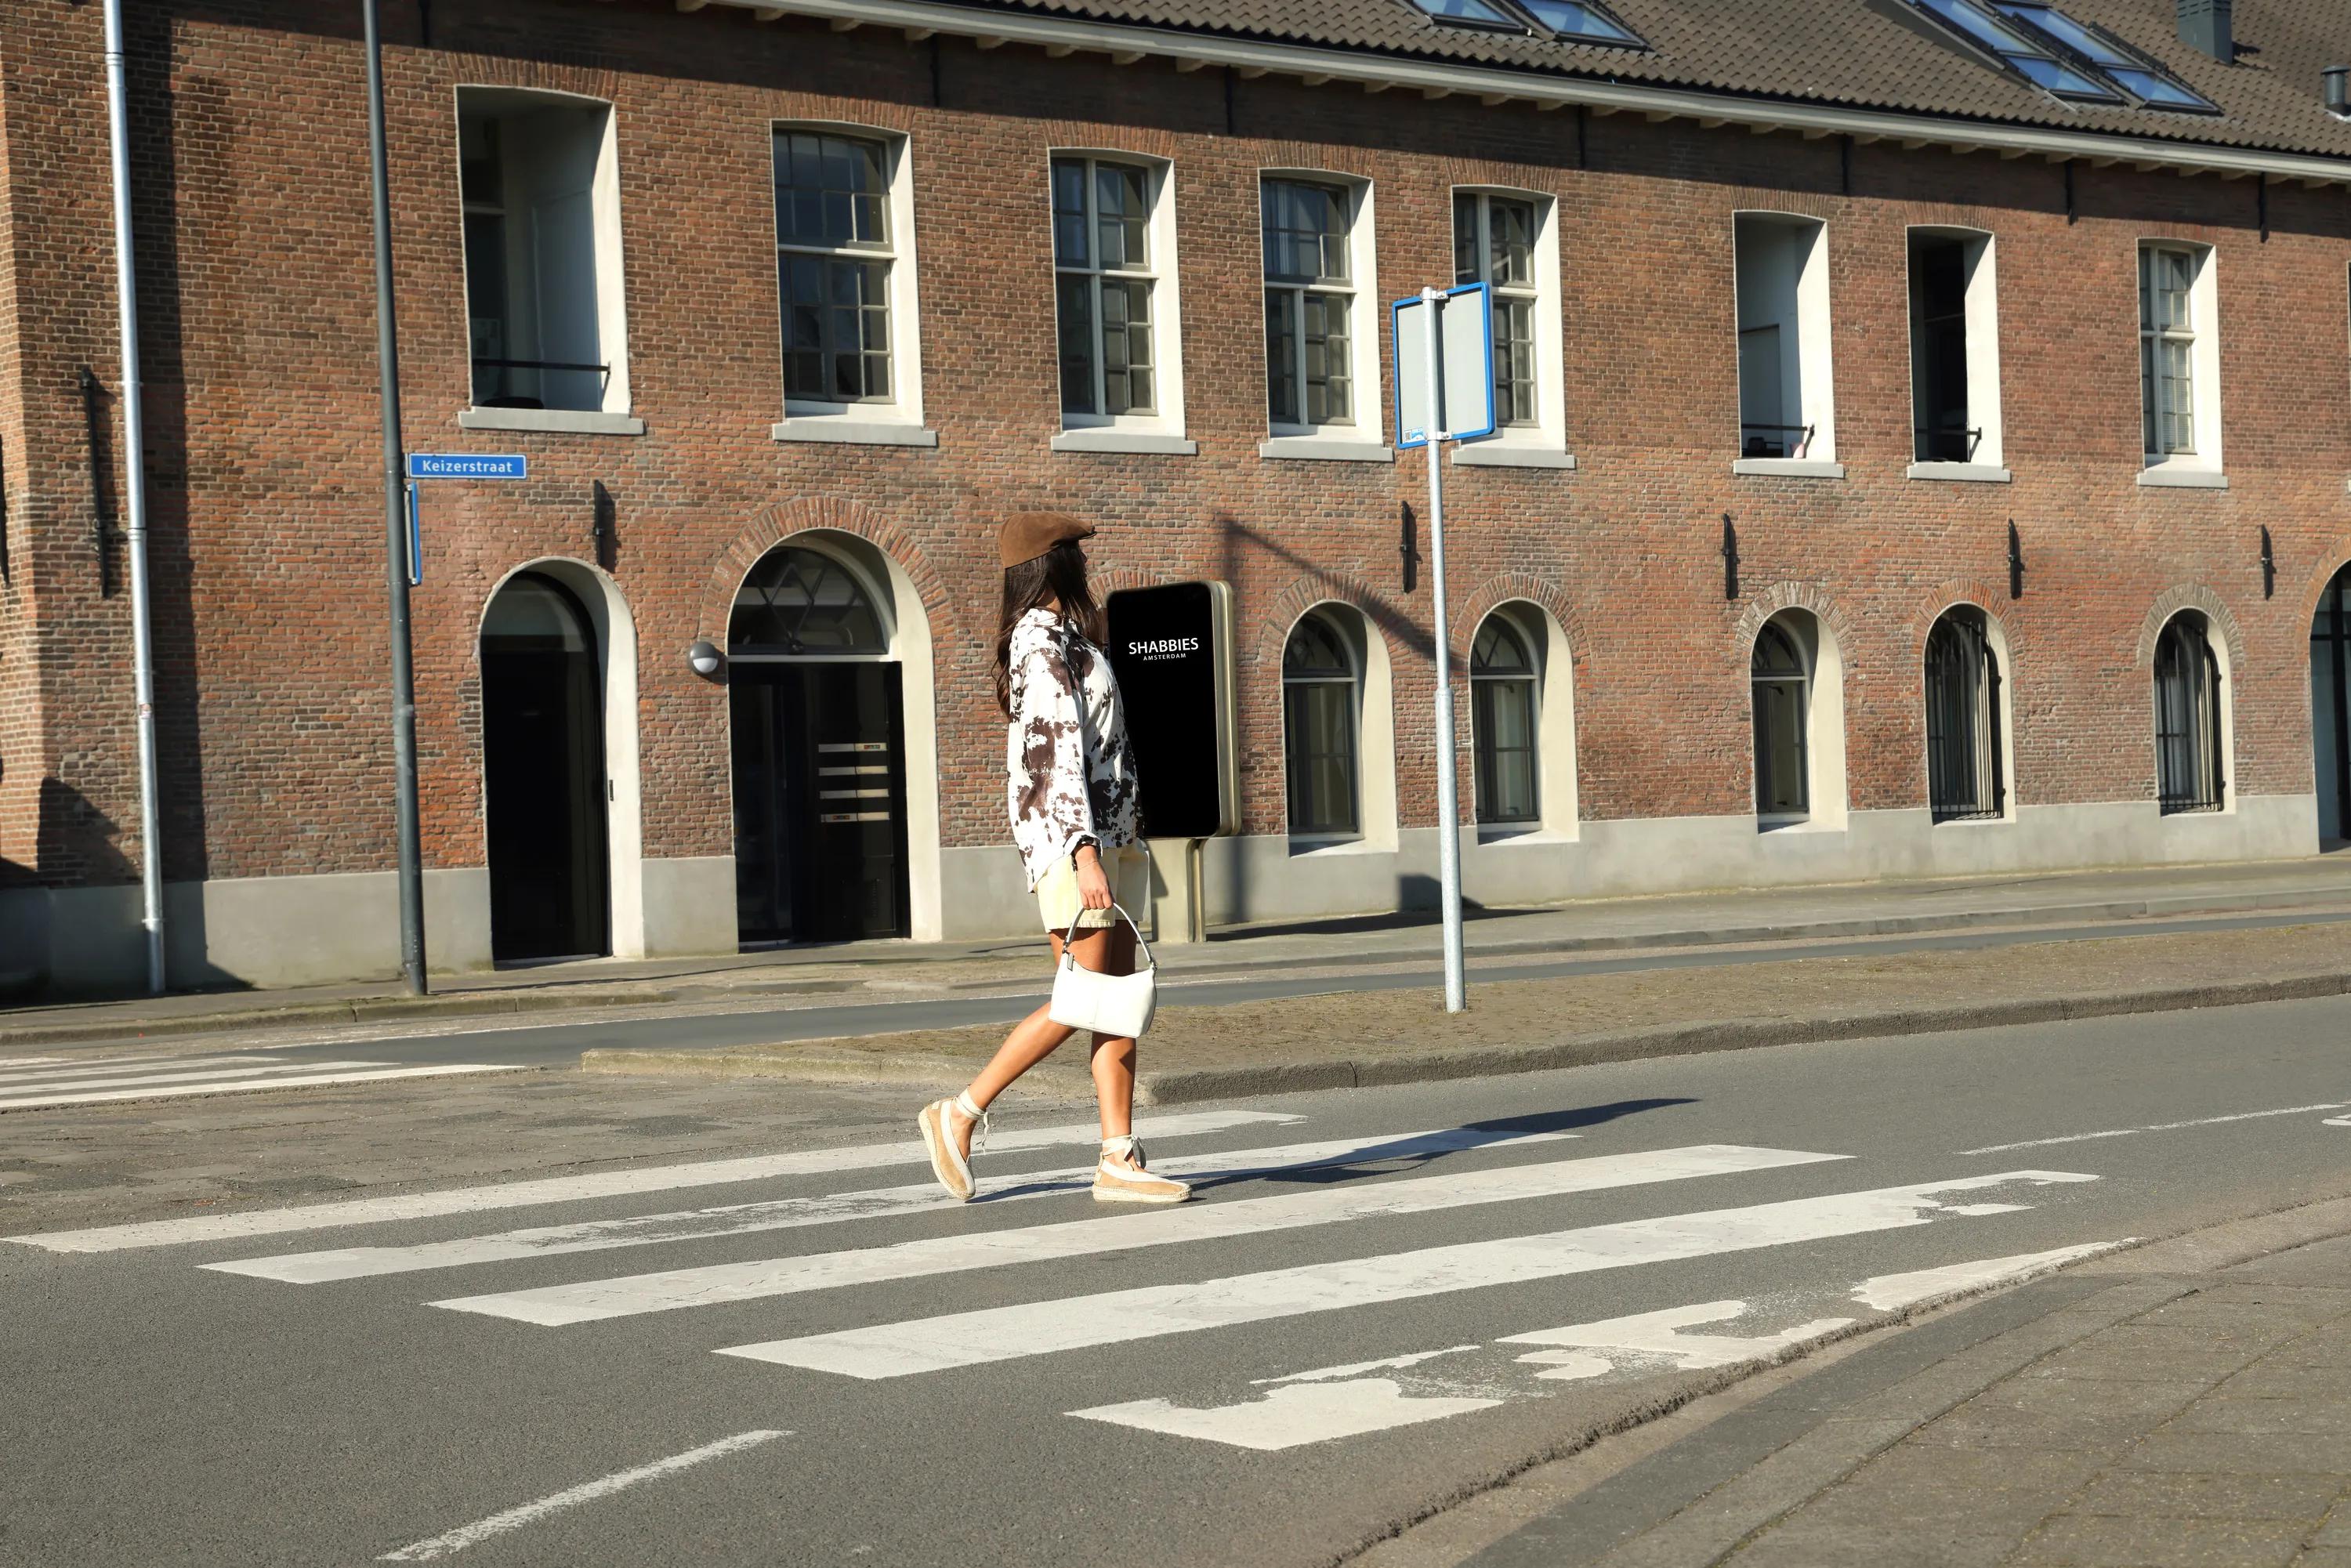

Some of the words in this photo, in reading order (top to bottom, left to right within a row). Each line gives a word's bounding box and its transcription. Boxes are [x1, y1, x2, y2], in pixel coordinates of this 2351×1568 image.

[422, 460, 513, 473] Keizerstraat
[1128, 637, 1199, 655] SHABBIES
[1143, 653, 1186, 661] AMSTERDAM
